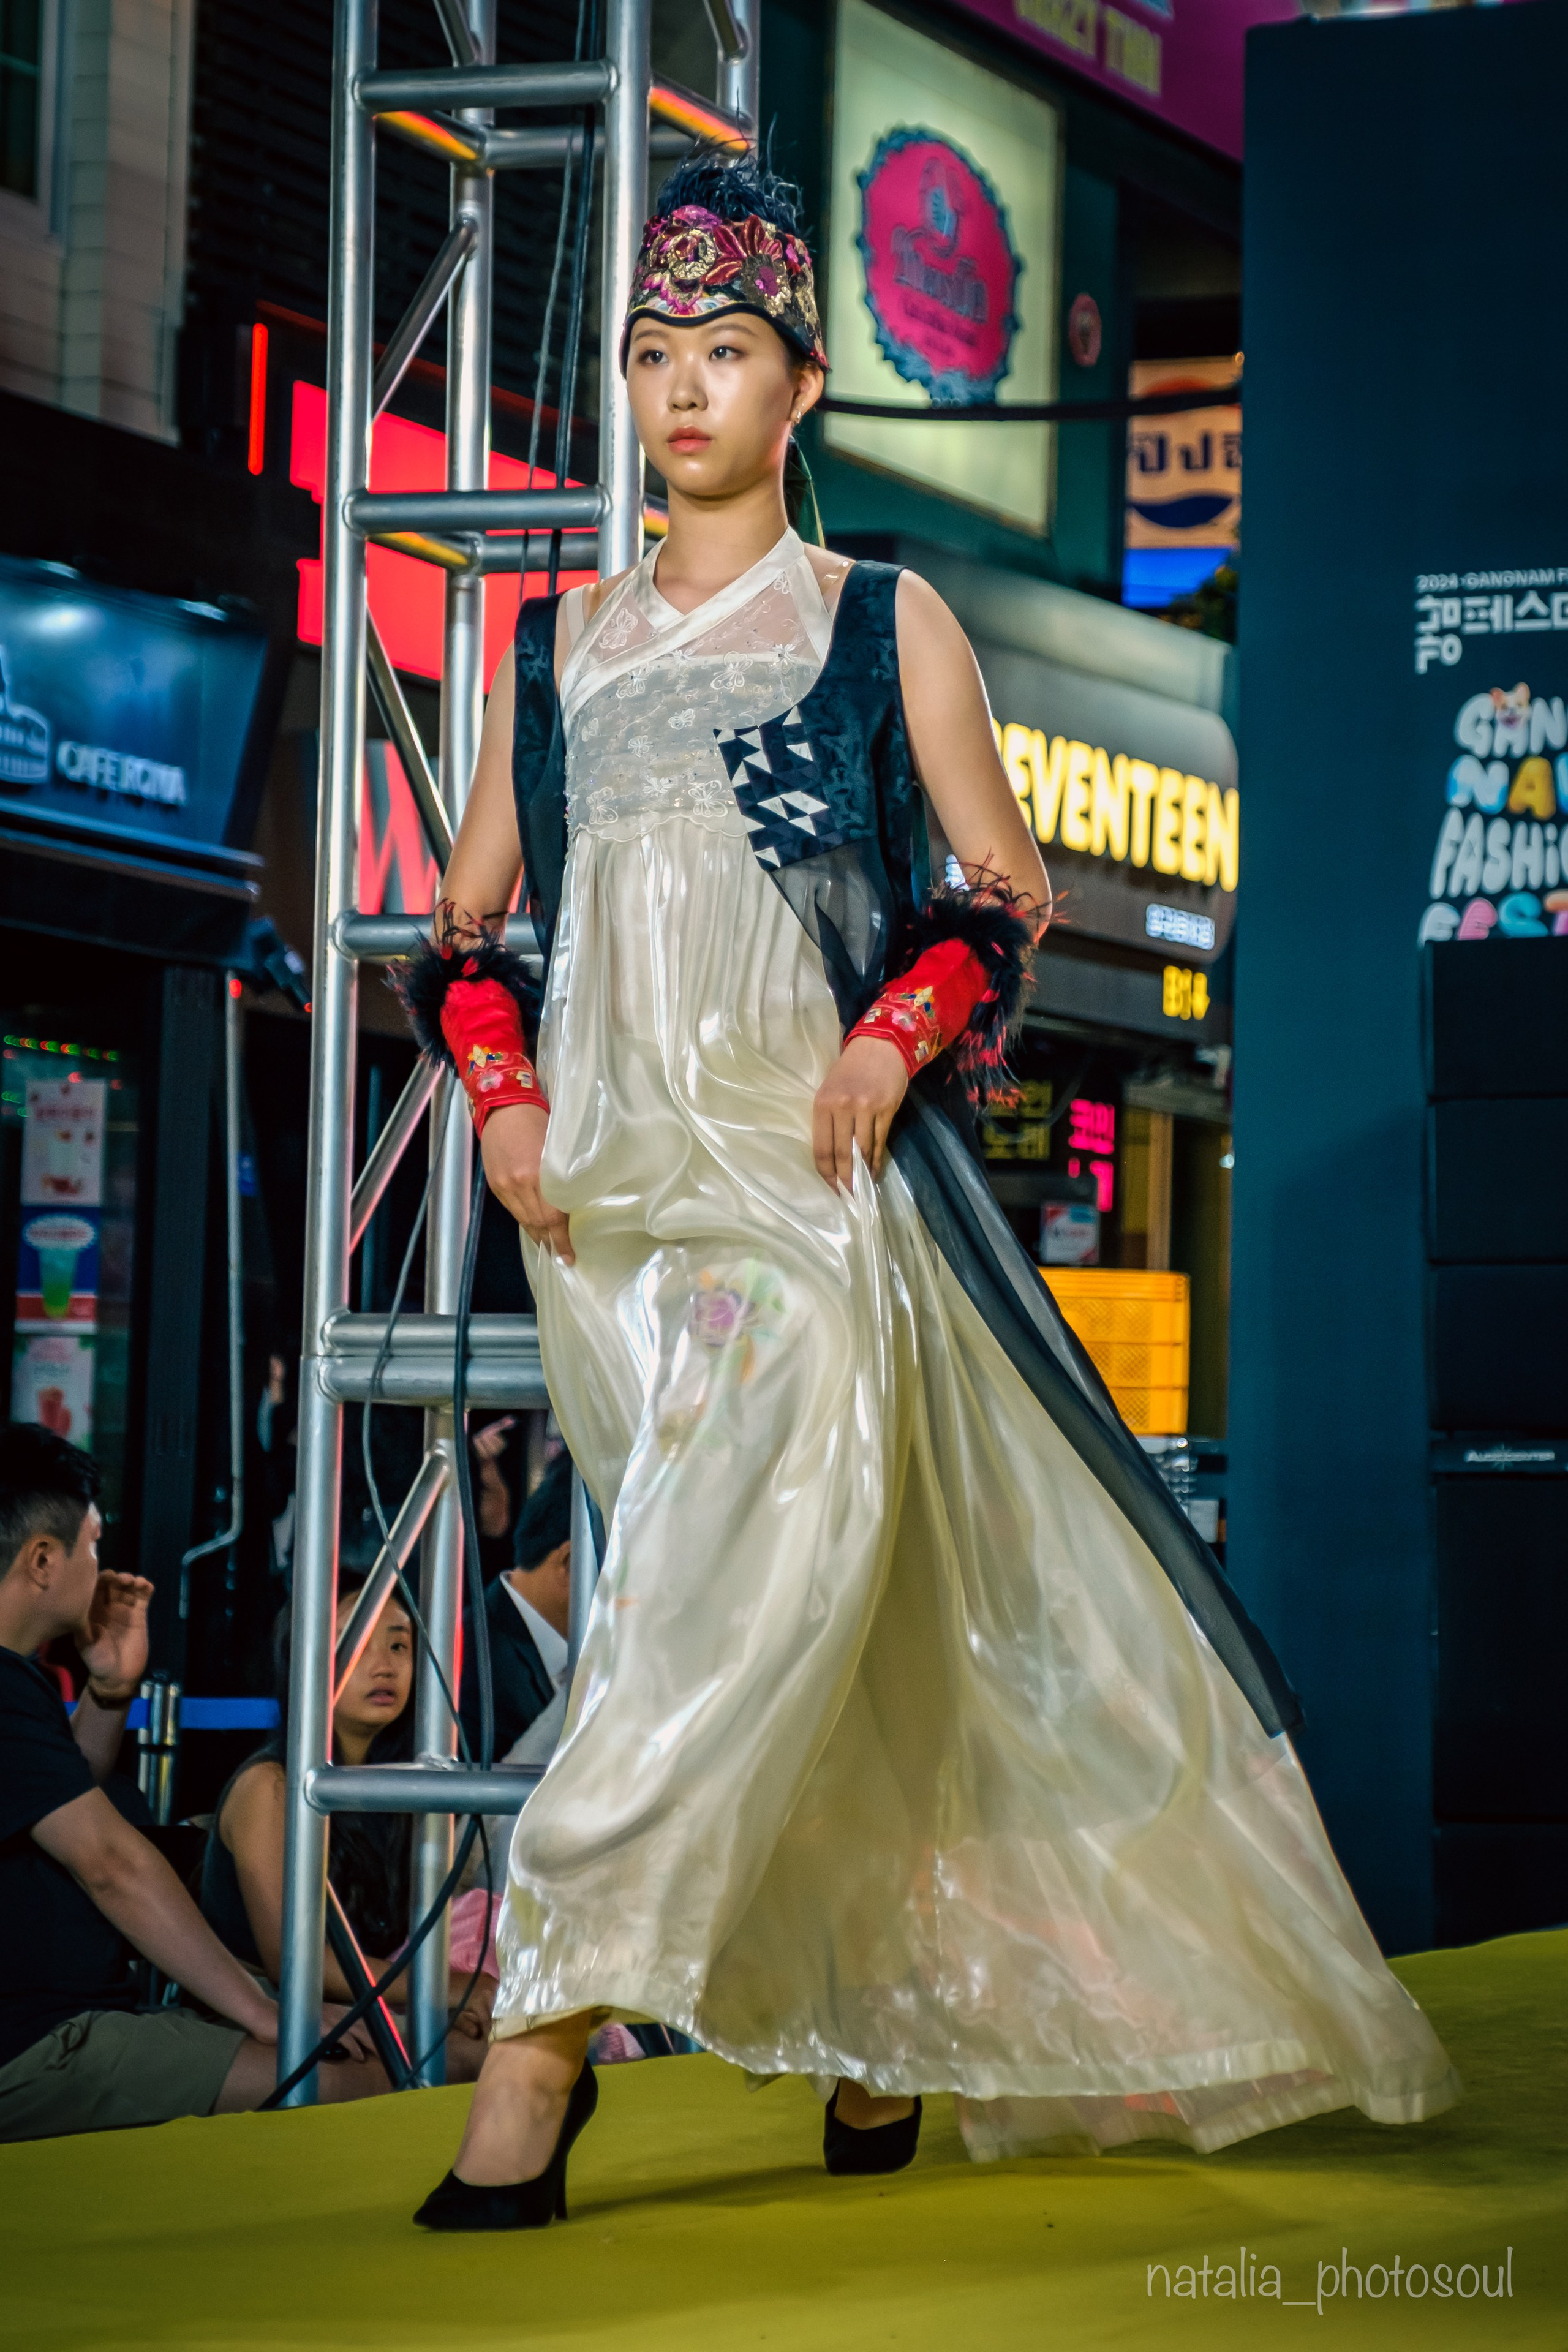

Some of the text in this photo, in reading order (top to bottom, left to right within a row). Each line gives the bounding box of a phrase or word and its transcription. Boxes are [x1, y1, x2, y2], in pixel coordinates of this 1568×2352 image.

[1415, 572, 1459, 593] 2024
[1462, 568, 1555, 590] GANGNAM
[1454, 685, 1568, 759] GAN
[992, 717, 1240, 892] EVENTEEN
[1446, 754, 1568, 821] NA
